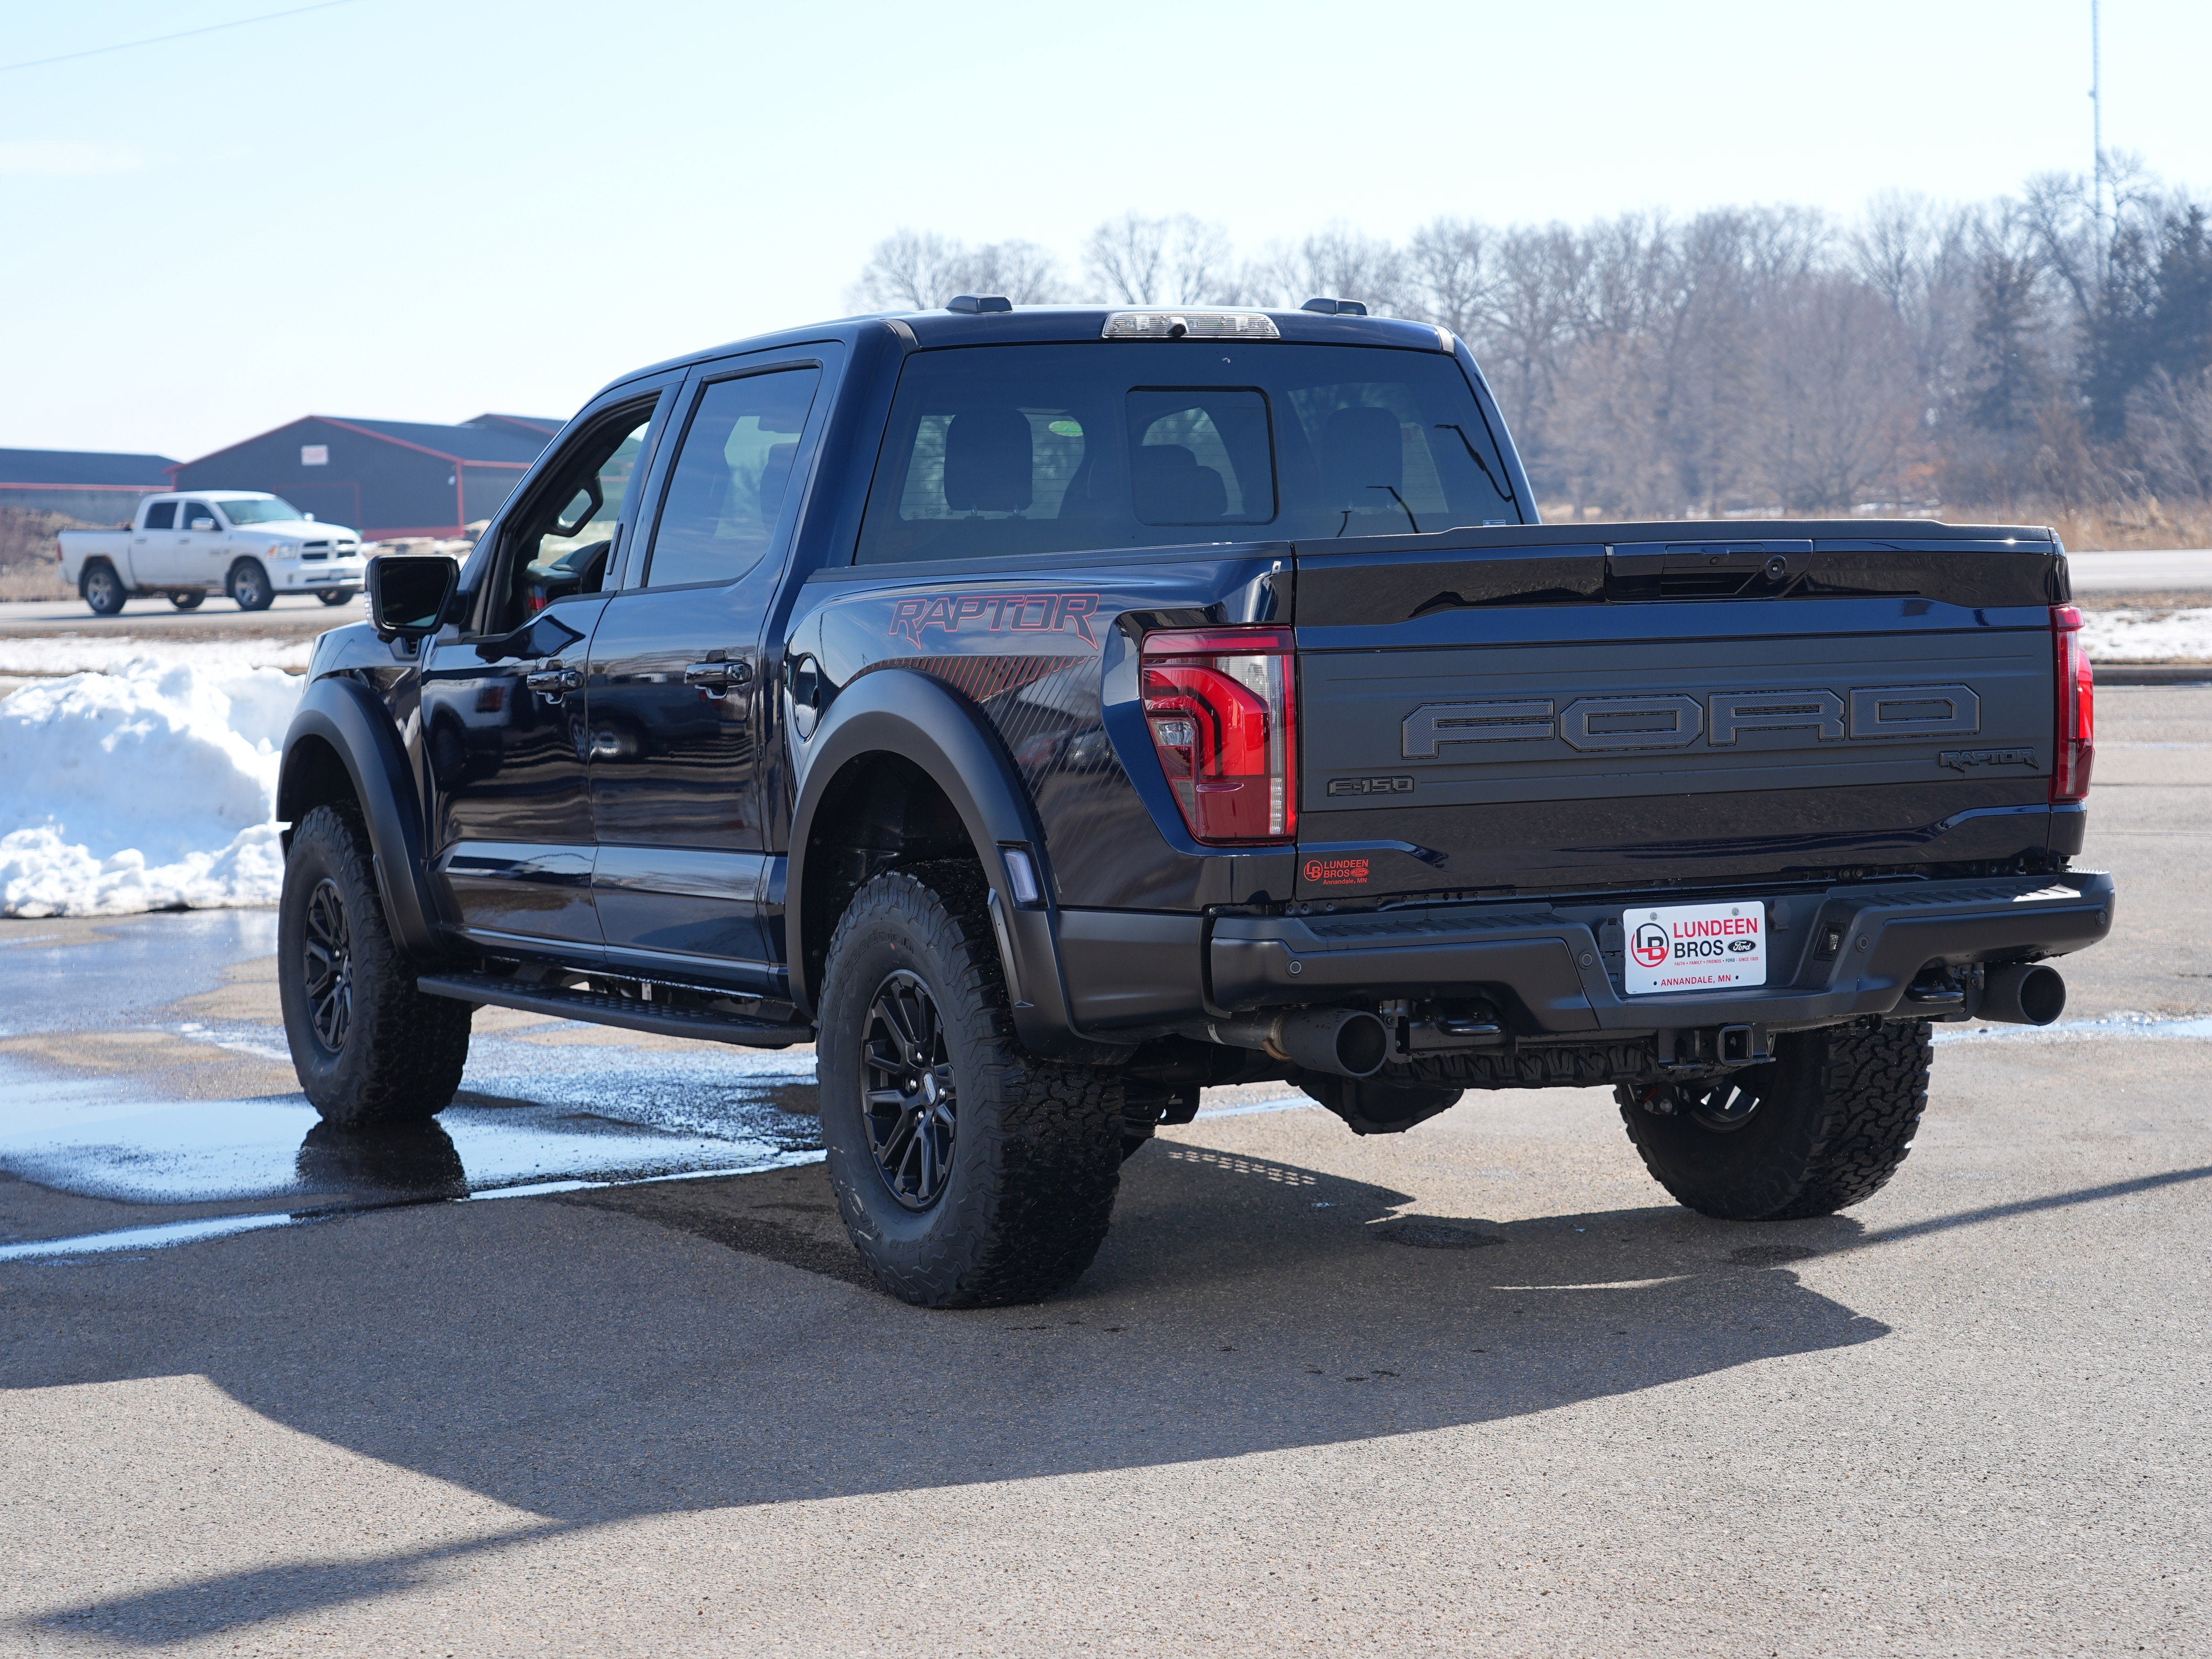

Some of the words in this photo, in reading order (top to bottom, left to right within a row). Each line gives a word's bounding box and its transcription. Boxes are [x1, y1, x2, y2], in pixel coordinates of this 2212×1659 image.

[889, 594, 1100, 650] RAPTOR
[1402, 683, 1981, 759] FORD
[1939, 747, 2040, 773] RAPTOR
[1327, 775, 1414, 797] F-150
[1323, 869, 1350, 879] BROS
[1324, 859, 1369, 869] LUNDEEN
[1674, 918, 1758, 938] LUNDEEN
[1674, 940, 1724, 959] BROS
[1732, 940, 1752, 952] Ford
[1661, 976, 1715, 986] ANNANDALE,
